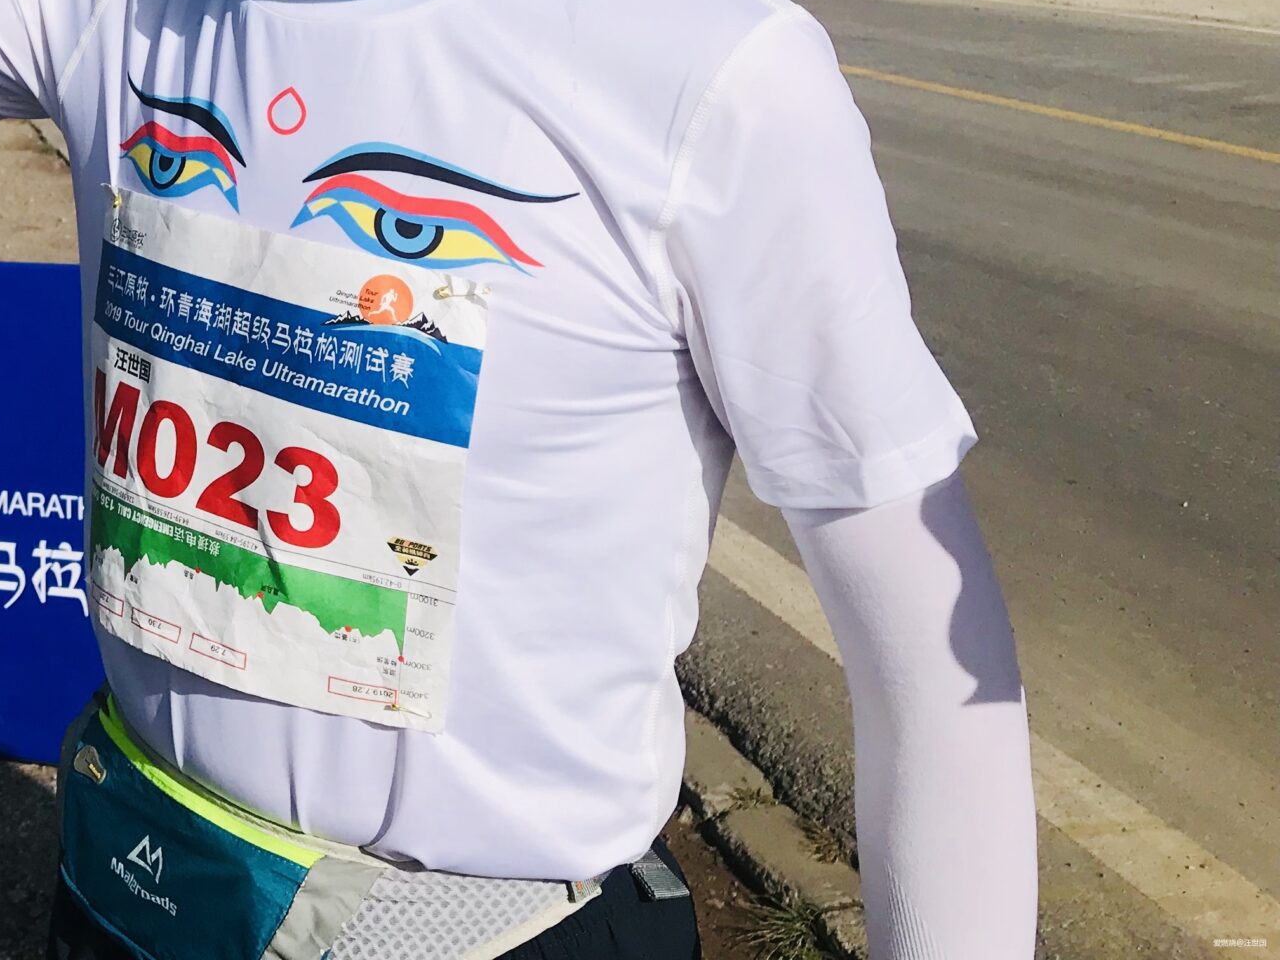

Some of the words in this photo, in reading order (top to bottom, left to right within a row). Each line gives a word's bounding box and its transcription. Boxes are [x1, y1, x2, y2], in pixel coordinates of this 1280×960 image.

[105, 300, 122, 322] 2019
[124, 310, 149, 334] Tour
[151, 322, 212, 357] Qinghai
[214, 344, 257, 372] Lake
[261, 359, 411, 416] Ultramarathon
[114, 347, 152, 384] 汪世国
[94, 366, 342, 549] M023
[117, 505, 132, 519] CALL
[174, 525, 221, 557] 救援电话
[406, 626, 435, 641] 3200m
[403, 660, 432, 672] 3300m
[352, 685, 394, 699] 2019.7.28
